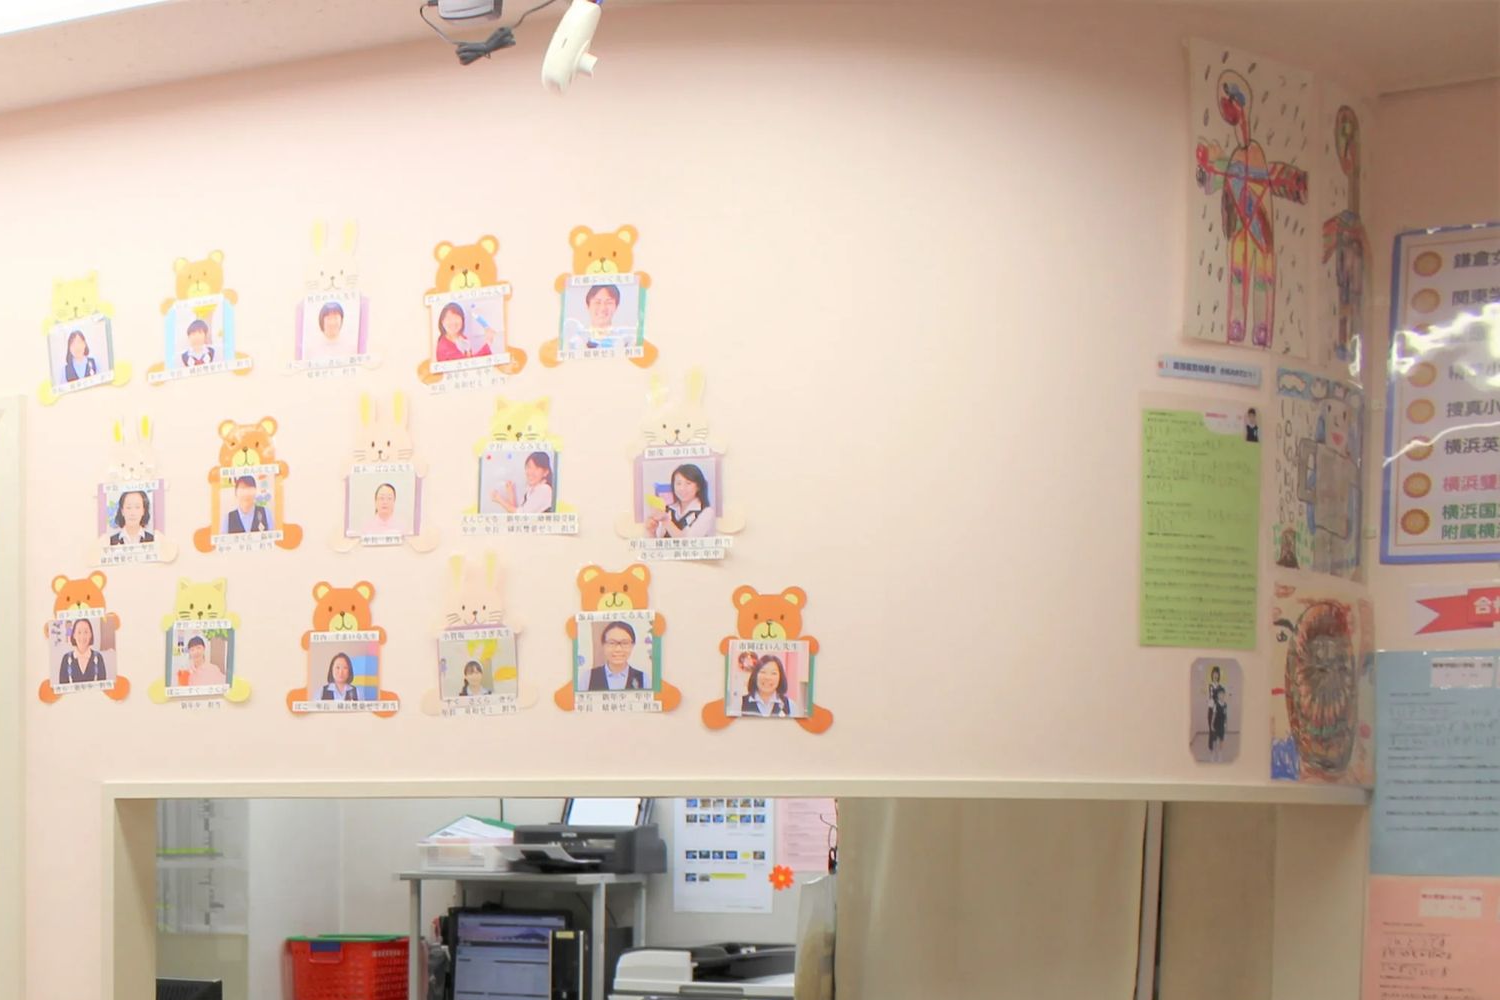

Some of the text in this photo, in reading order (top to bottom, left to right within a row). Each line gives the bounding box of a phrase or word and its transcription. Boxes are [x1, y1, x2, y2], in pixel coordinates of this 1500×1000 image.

[1442, 502, 1500, 520] 横浜国
[1441, 522, 1500, 540] 附属横
